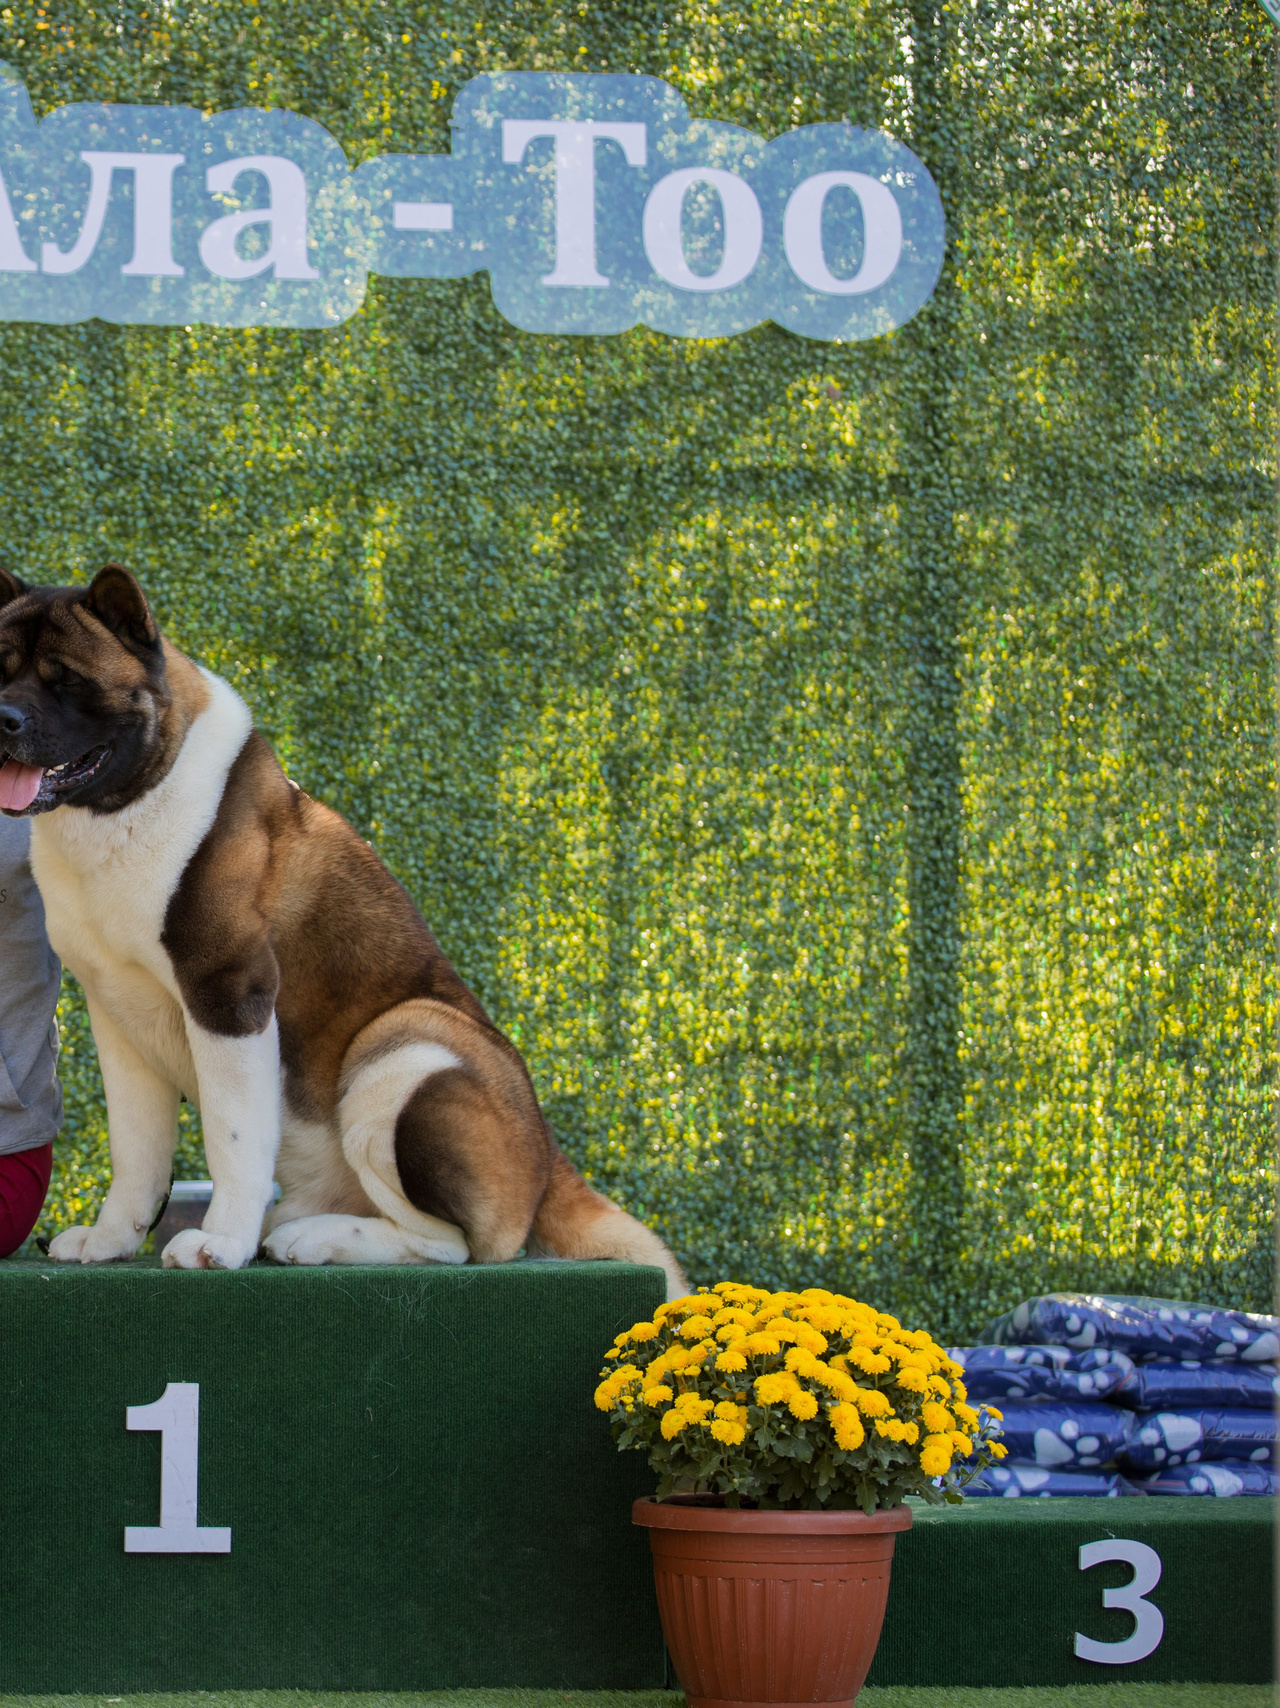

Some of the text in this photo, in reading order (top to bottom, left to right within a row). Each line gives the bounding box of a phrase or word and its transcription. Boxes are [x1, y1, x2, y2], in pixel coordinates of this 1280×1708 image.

[501, 119, 904, 295] Тоо
[124, 1382, 232, 1554] 1
[1073, 1538, 1165, 1665] 3
